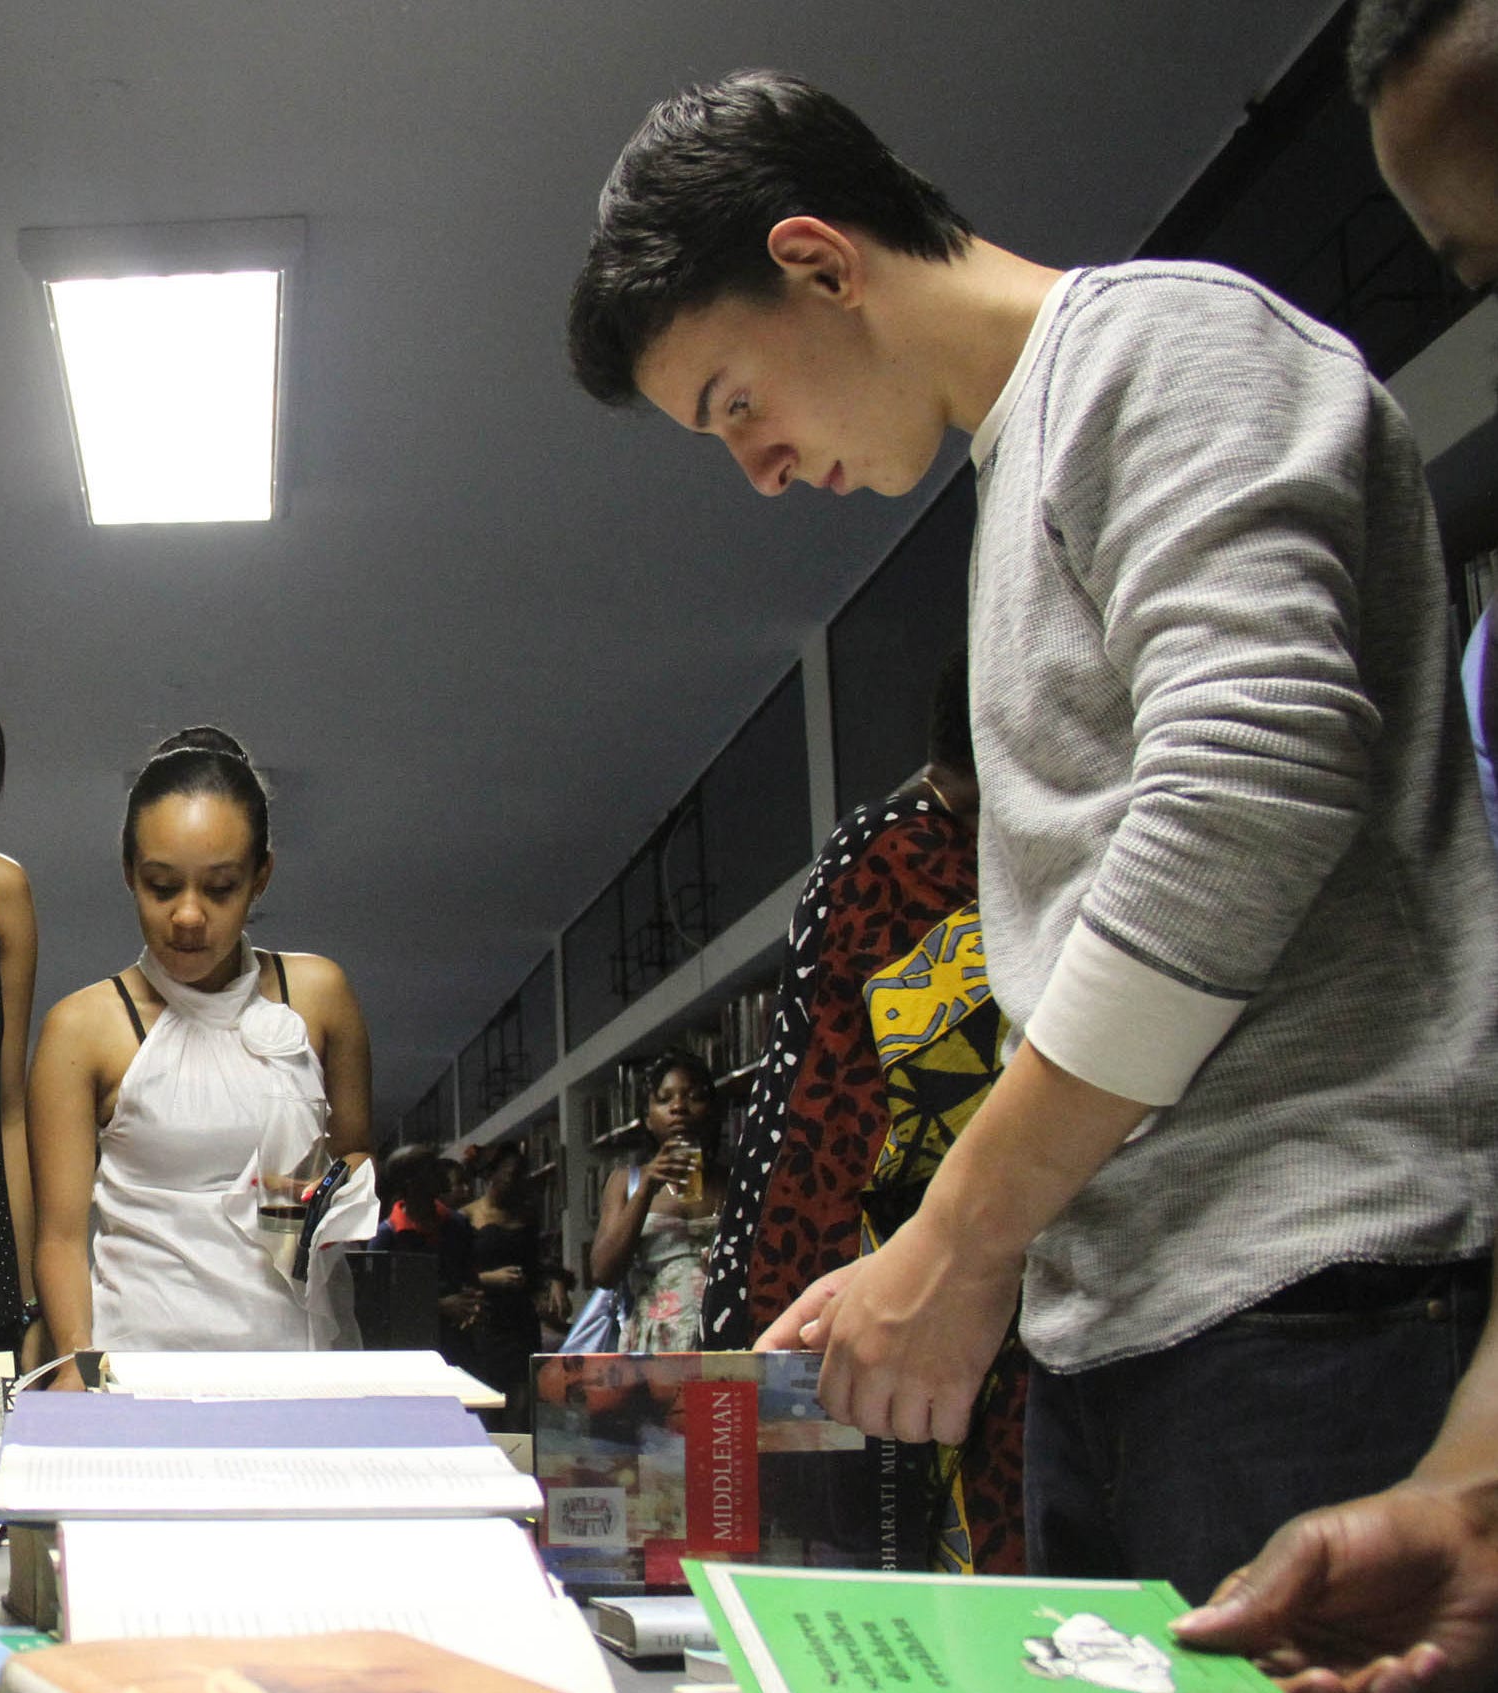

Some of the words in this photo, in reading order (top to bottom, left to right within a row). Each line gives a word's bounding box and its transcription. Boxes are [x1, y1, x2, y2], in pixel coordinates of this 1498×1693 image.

[733, 1391, 743, 1450] STORIES
[712, 1391, 732, 1541] MIDDLEMAN
[733, 1457, 743, 1506] OTHER
[733, 1513, 743, 1542] AND
[880, 1484, 897, 1572] BHARATI
[653, 1632, 694, 1648] THE
